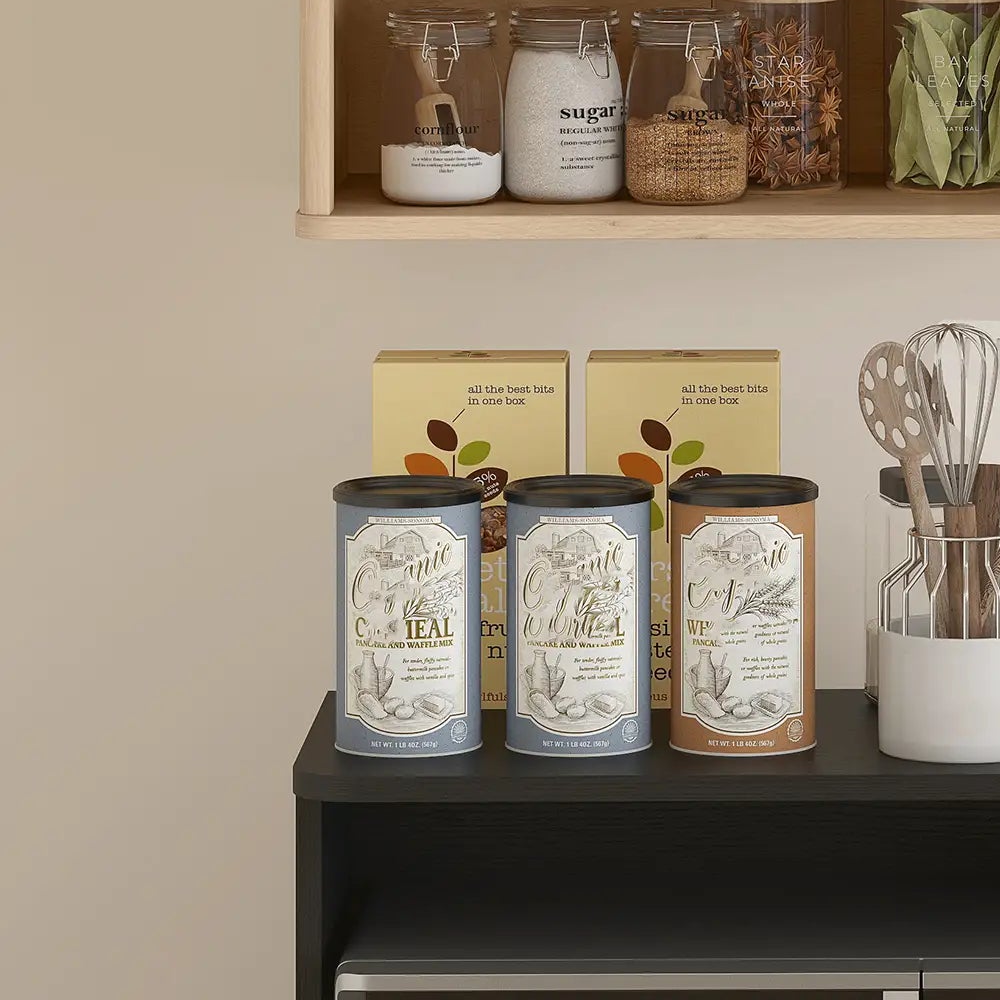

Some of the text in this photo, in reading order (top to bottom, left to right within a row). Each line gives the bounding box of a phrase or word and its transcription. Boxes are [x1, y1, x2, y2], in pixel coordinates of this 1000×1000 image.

[754, 55, 805, 68] STAR
[934, 55, 973, 68] BAY
[748, 75, 810, 88] ANISE
[917, 74, 990, 88] LEAVES
[560, 106, 616, 125] sugar
[414, 121, 480, 136] cornflour
[560, 127, 602, 136] REGULAR
[468, 385, 555, 394] all the best bits
[681, 384, 769, 394] all the best bits
[468, 396, 526, 405] in one box
[681, 396, 740, 405] in one box
[387, 641, 405, 649] AND
[406, 640, 438, 649] WAFFLE
[439, 639, 454, 648] MIX
[559, 641, 577, 649] AND
[610, 639, 625, 647] MIX
[371, 740, 382, 748] NET
[394, 740, 398, 748] 1
[399, 740, 406, 748] LB
[422, 740, 438, 748] (567g)
[542, 740, 553, 748] NET
[566, 740, 570, 748] 1
[570, 740, 578, 748] LB
[593, 740, 610, 748] (567g)
[708, 740, 718, 748] NET
[732, 740, 735, 748] 1
[736, 740, 744, 748] LB
[758, 740, 775, 748] (567g)
